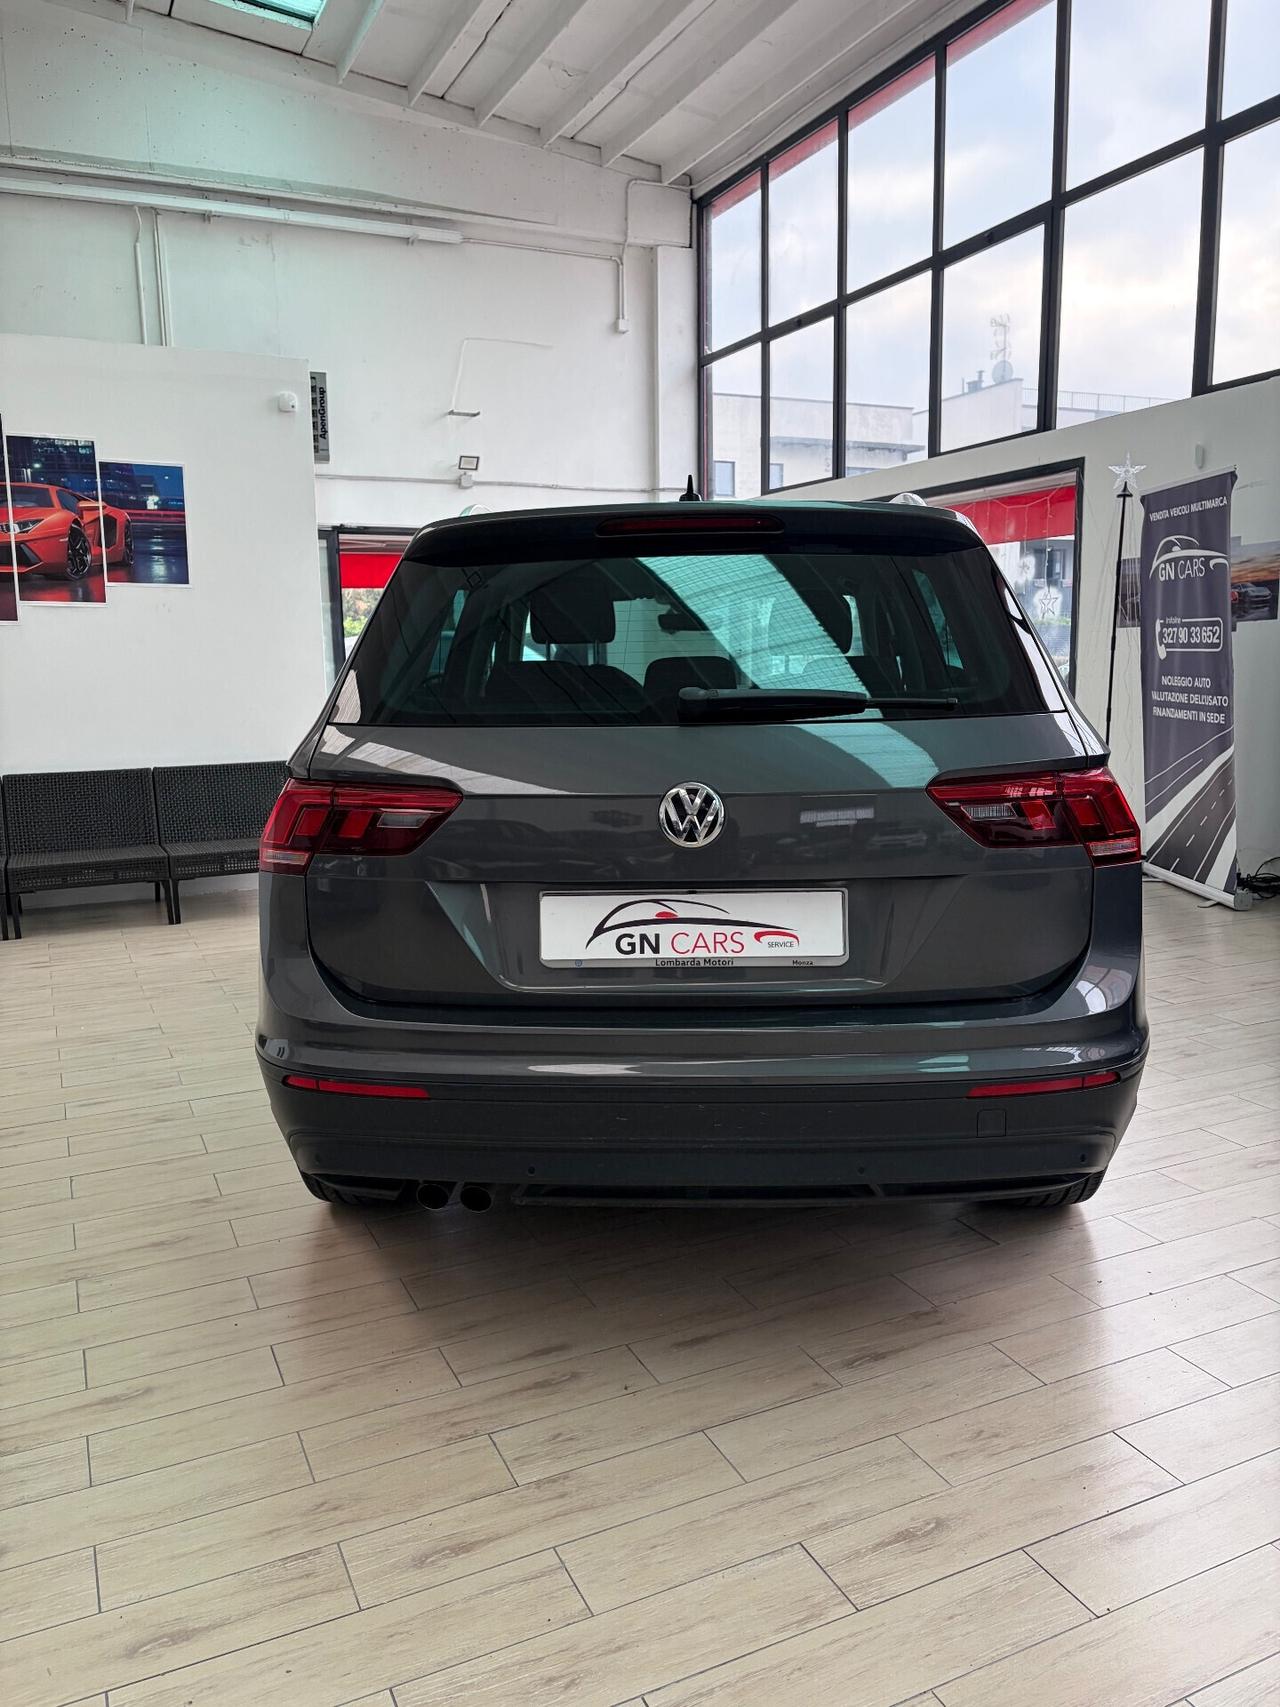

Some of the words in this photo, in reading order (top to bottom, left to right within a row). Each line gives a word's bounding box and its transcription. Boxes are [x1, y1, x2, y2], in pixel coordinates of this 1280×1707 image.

[318, 387, 328, 440] ApenGroup
[1149, 509, 1170, 522] VENDITA
[1191, 496, 1228, 513] MULTIMARCA
[1158, 561, 1175, 582] GN
[1177, 557, 1206, 580] CARS
[1162, 627, 1178, 644] 327
[1178, 627, 1189, 644] 90
[1190, 626, 1201, 644] 33
[1201, 625, 1220, 644] 652
[1161, 675, 1193, 688] NOLEGGIO
[1194, 677, 1211, 689] AUTO
[1199, 710, 1206, 722] IN
[1206, 712, 1226, 724] SEDE
[615, 932, 660, 955] GN
[670, 931, 745, 955] CARS
[655, 958, 701, 967] Lombarda
[703, 958, 734, 967] Motori
